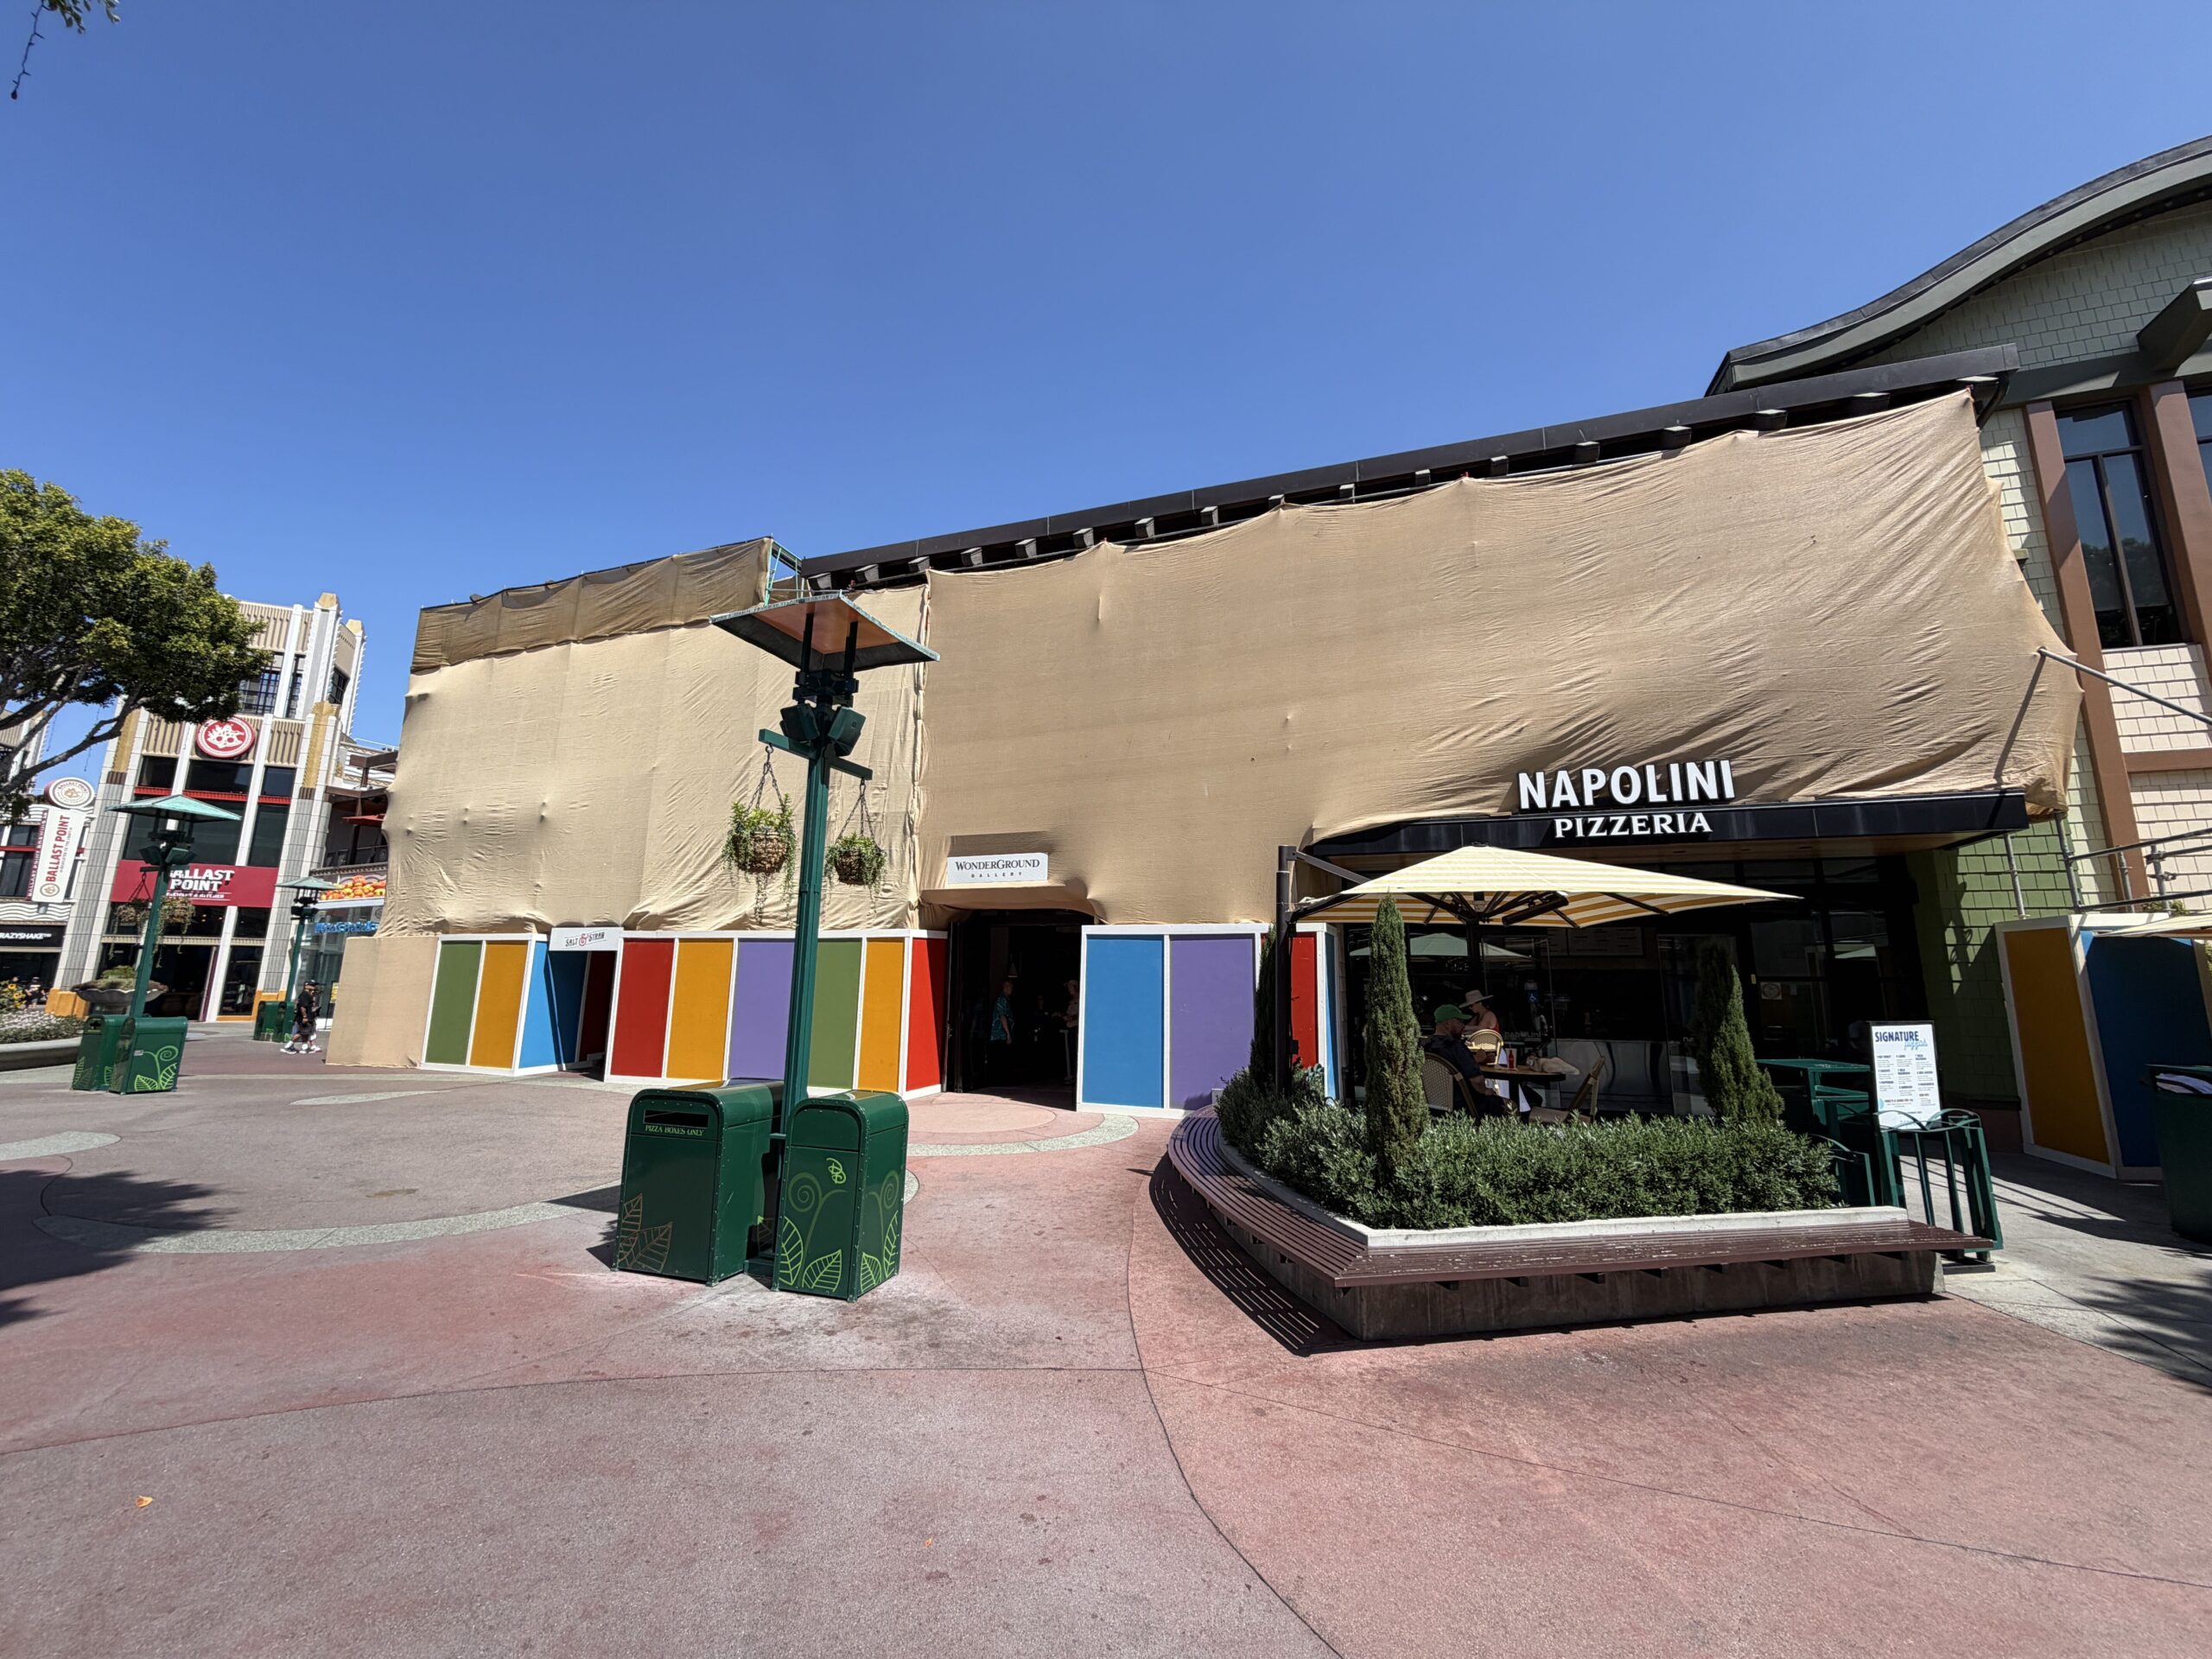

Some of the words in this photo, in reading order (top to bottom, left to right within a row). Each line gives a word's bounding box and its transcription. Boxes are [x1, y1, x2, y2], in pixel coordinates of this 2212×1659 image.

[1518, 760, 1735, 810] NAPOLINI
[1555, 812, 1713, 838] PIZZERIA
[46, 843, 61, 882] BALLAST
[55, 815, 70, 842] POINT
[170, 880, 222, 891] POINT
[565, 938, 578, 947] SALT
[579, 933, 588, 946] &
[588, 931, 605, 942] STRAW
[1875, 1031, 1919, 1042] SIGNATURE
